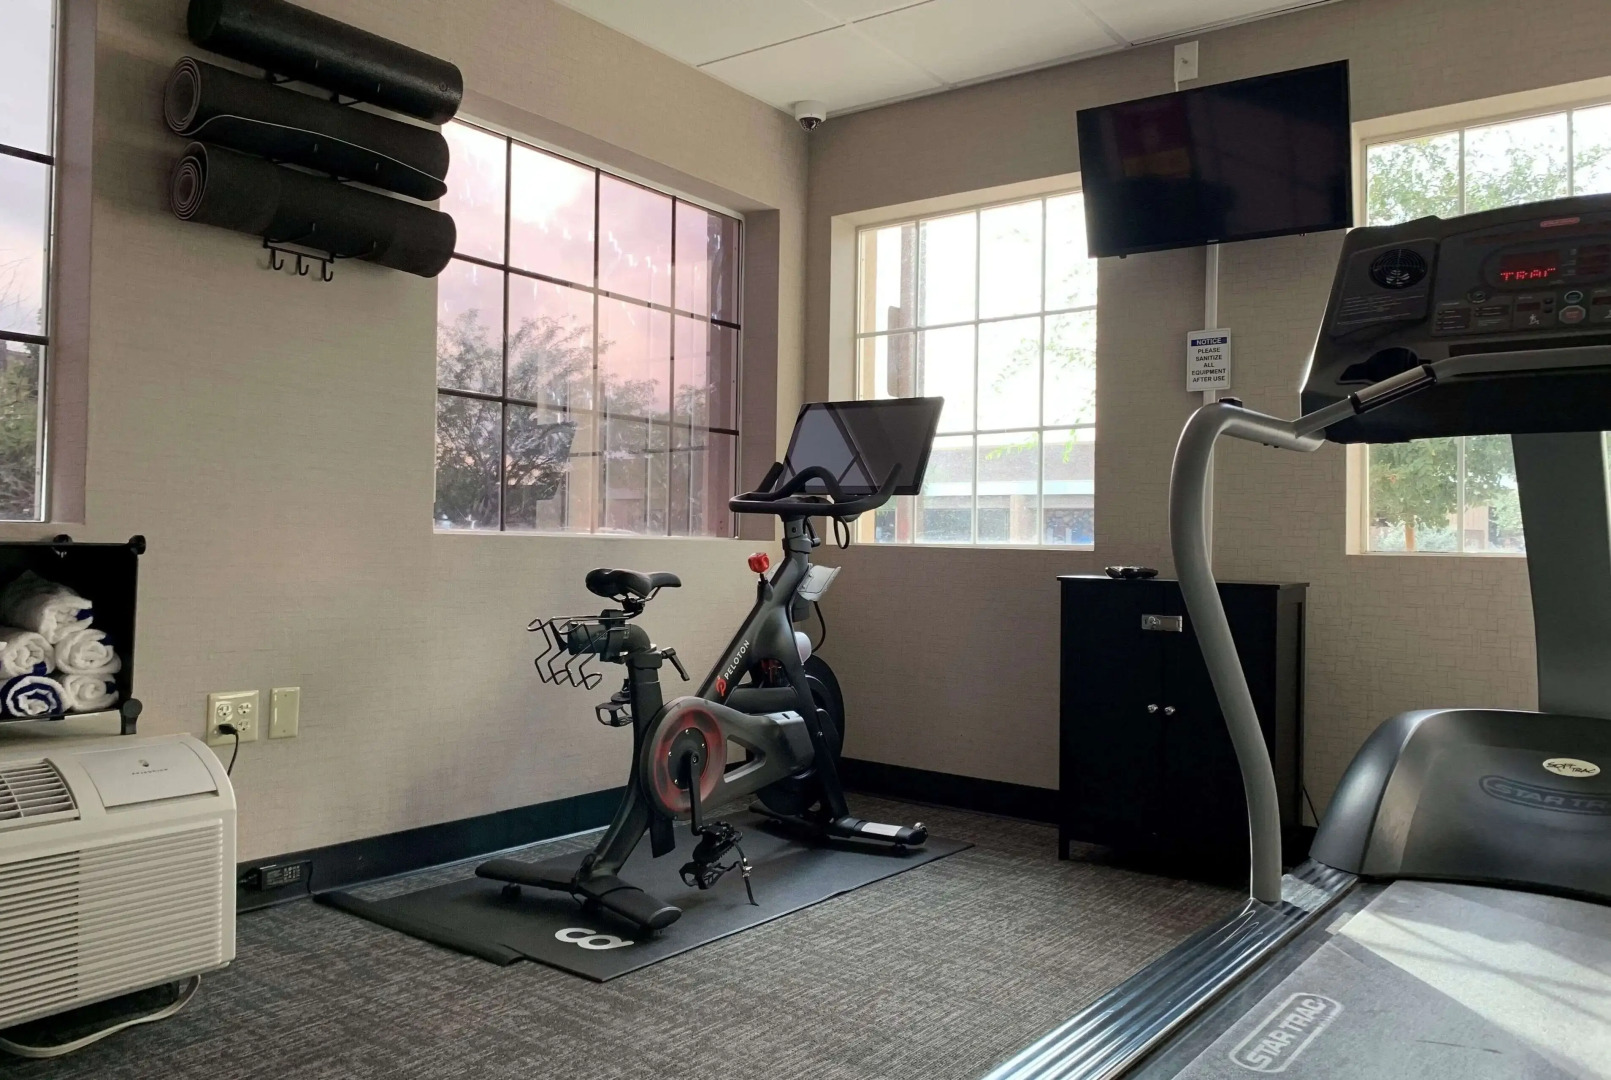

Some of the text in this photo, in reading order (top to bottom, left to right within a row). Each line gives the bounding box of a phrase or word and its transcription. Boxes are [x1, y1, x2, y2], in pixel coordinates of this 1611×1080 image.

[723, 639, 750, 680] PELOTON
[1494, 783, 1611, 809] STAR TR
[1246, 997, 1328, 1070] STAR TRAC
